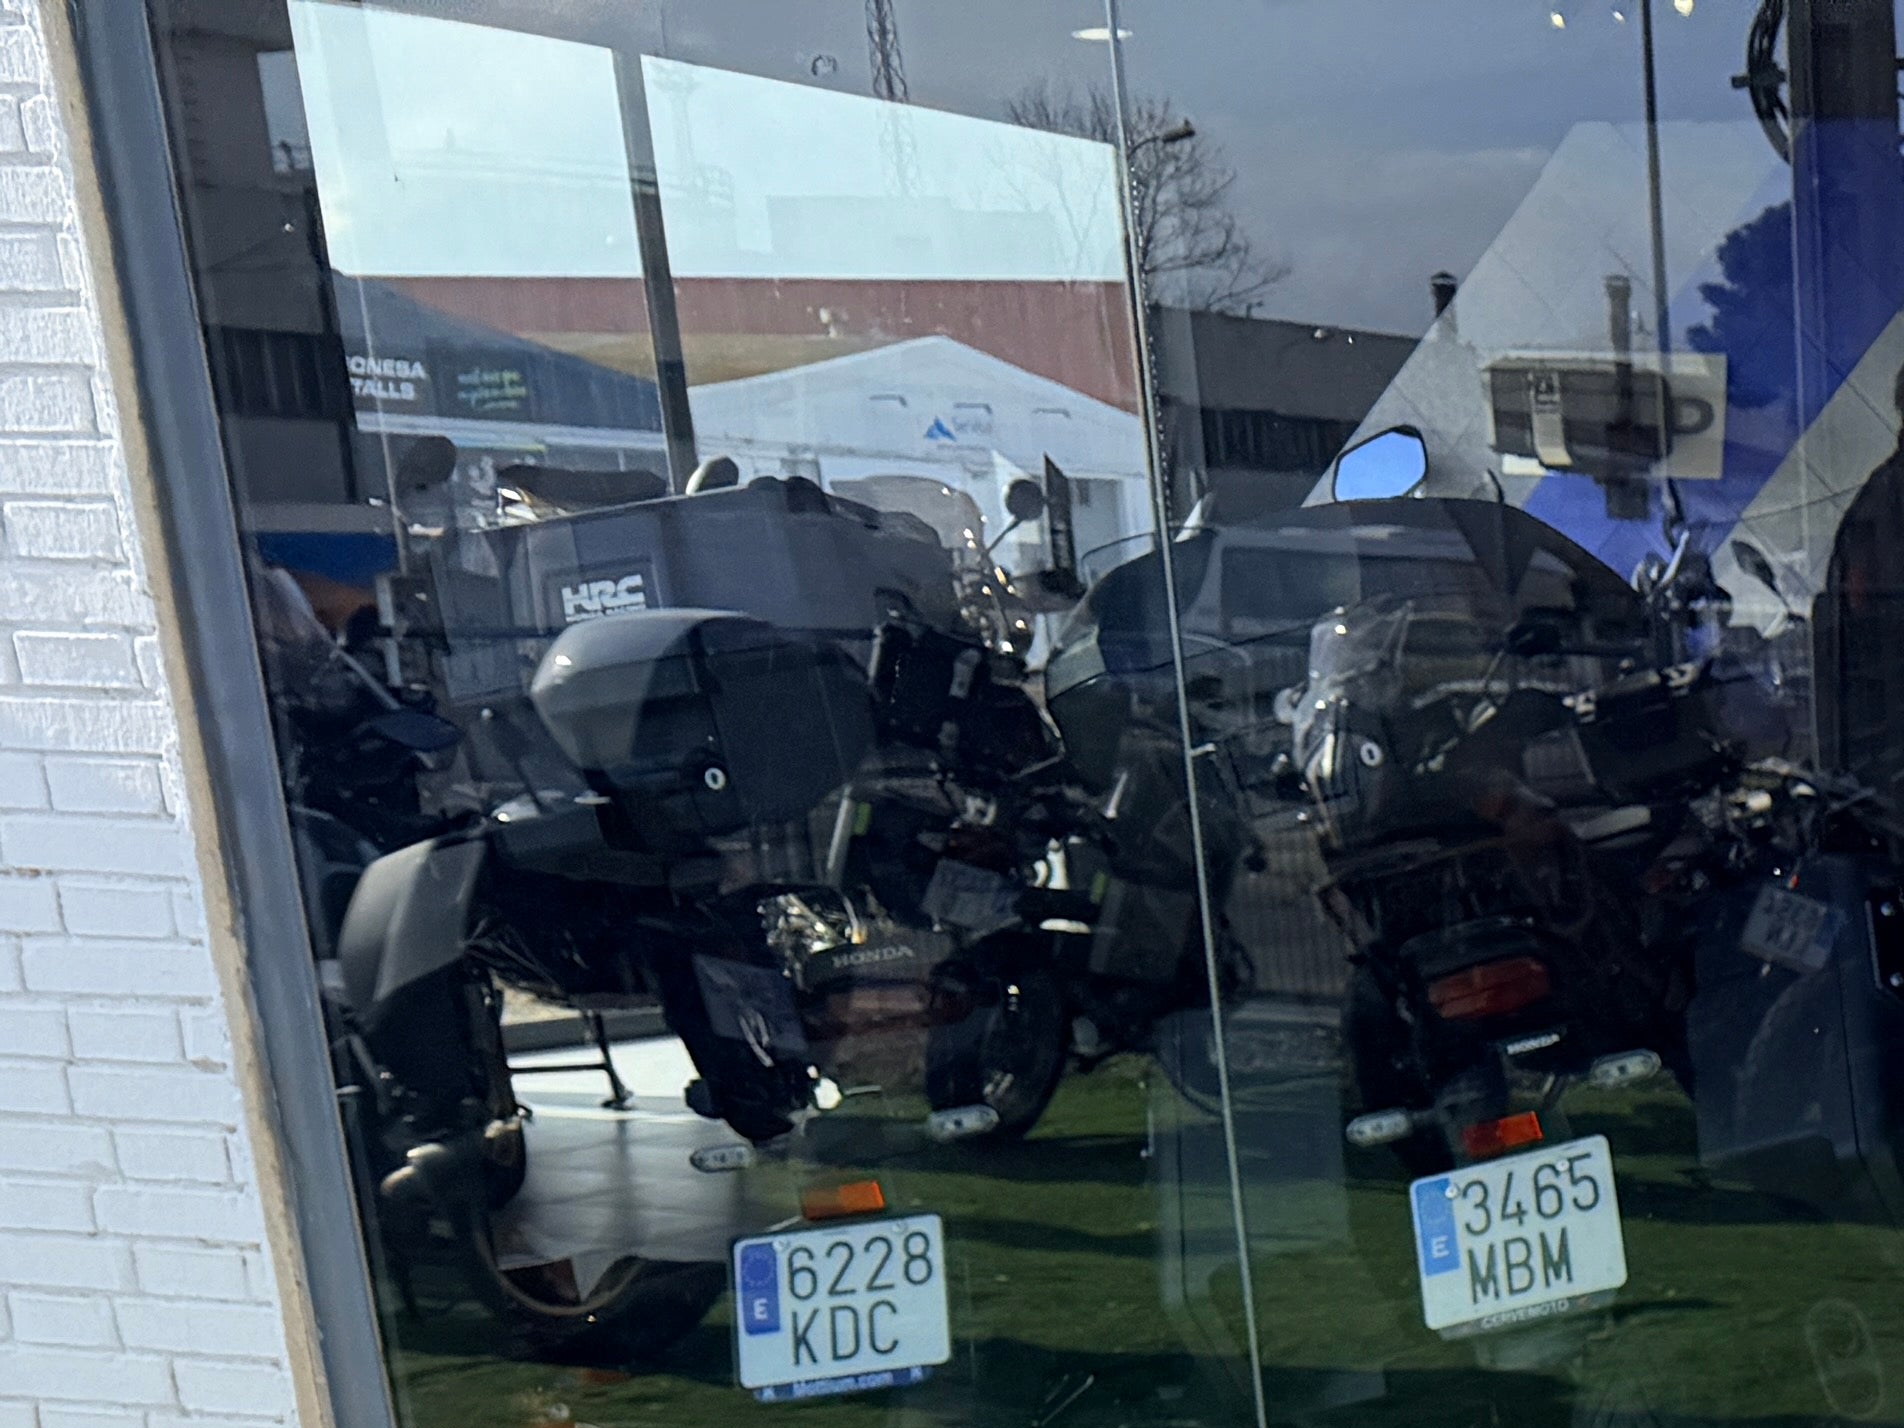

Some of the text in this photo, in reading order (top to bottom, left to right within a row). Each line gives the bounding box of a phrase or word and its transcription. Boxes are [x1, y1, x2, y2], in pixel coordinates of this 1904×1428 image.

[561, 574, 645, 615] HRC
[1462, 1153, 1600, 1236] 3465
[788, 1231, 933, 1300] 6228
[1432, 1235, 1449, 1258] E
[1468, 1227, 1573, 1304] MBM
[753, 1298, 769, 1320] E
[792, 1300, 899, 1366] KDC
